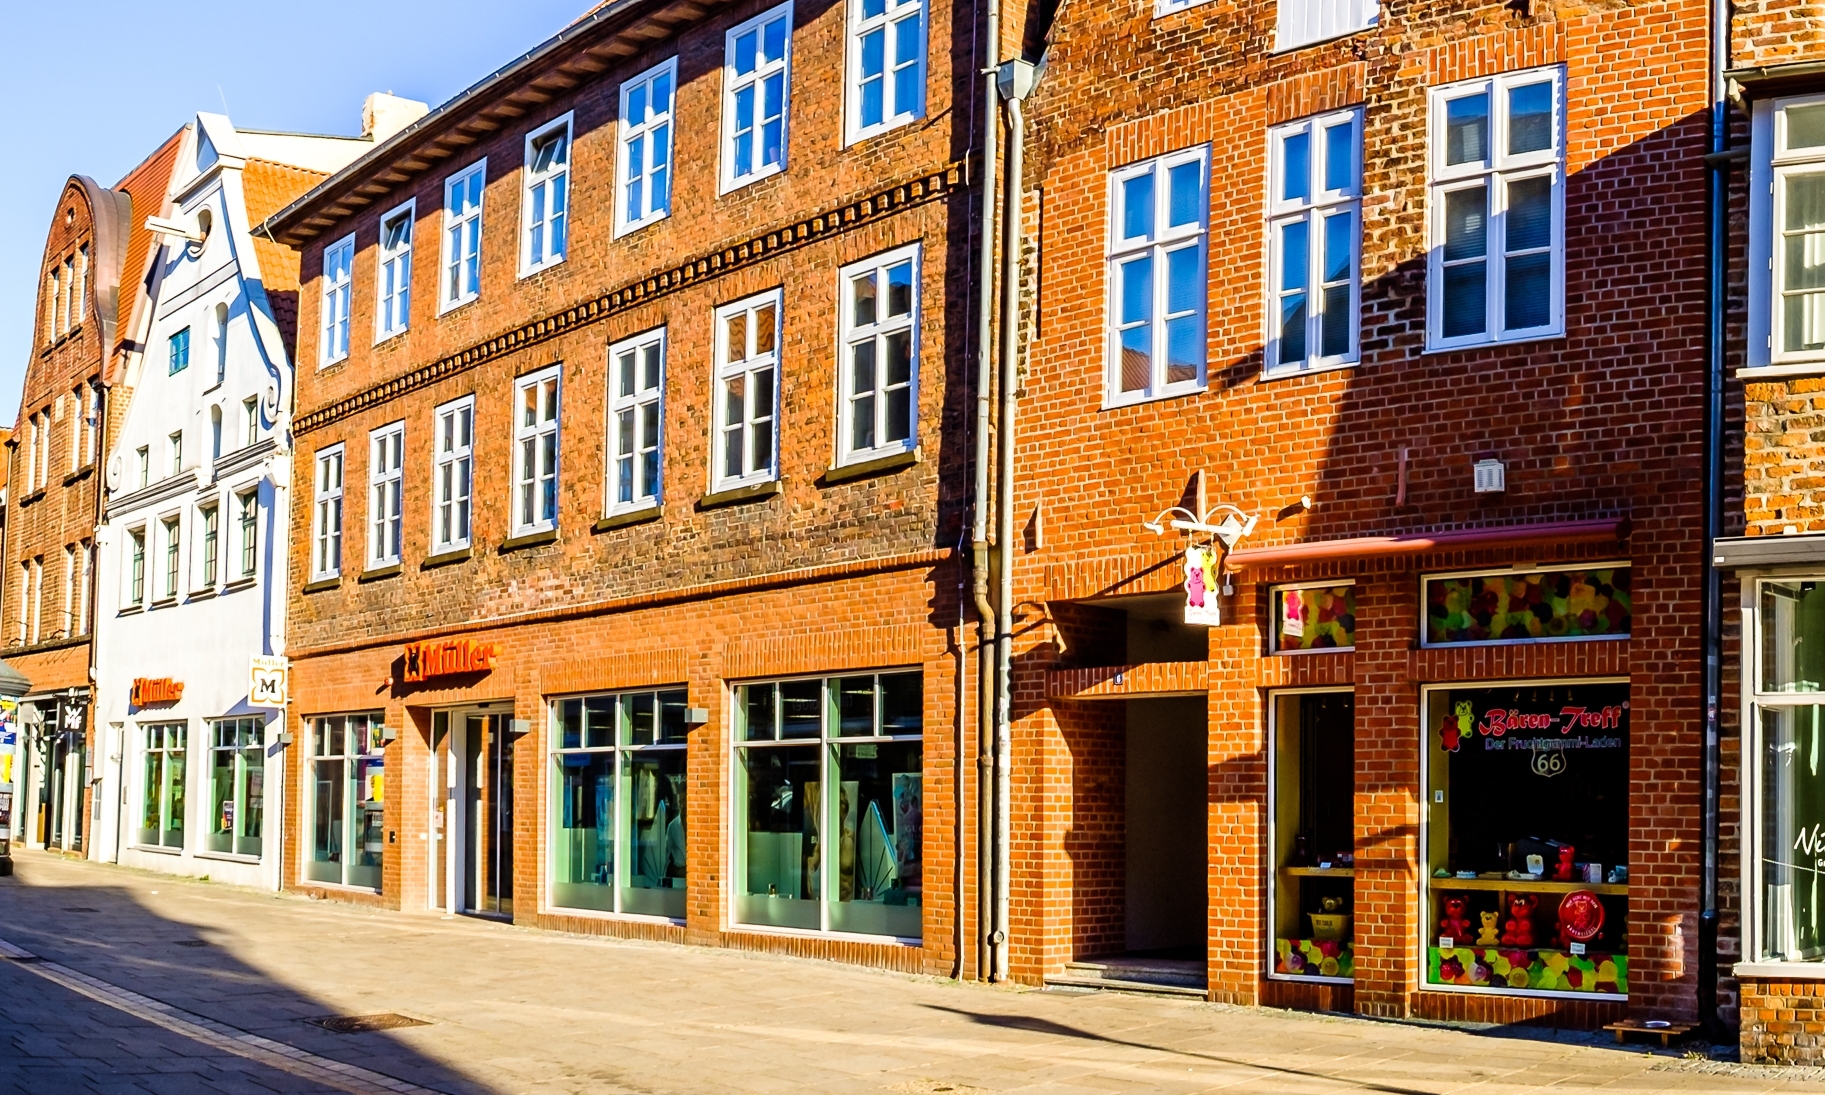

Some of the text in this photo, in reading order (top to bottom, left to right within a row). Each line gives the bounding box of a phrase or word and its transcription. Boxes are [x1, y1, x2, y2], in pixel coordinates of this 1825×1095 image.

[424, 640, 496, 676] Müller
[142, 678, 181, 703] Müller
[260, 677, 276, 694] M
[1478, 705, 1622, 737] Bären-Treff
[1485, 735, 1622, 752] Der Fruchtgummi-Laden
[1537, 753, 1561, 772] 66
